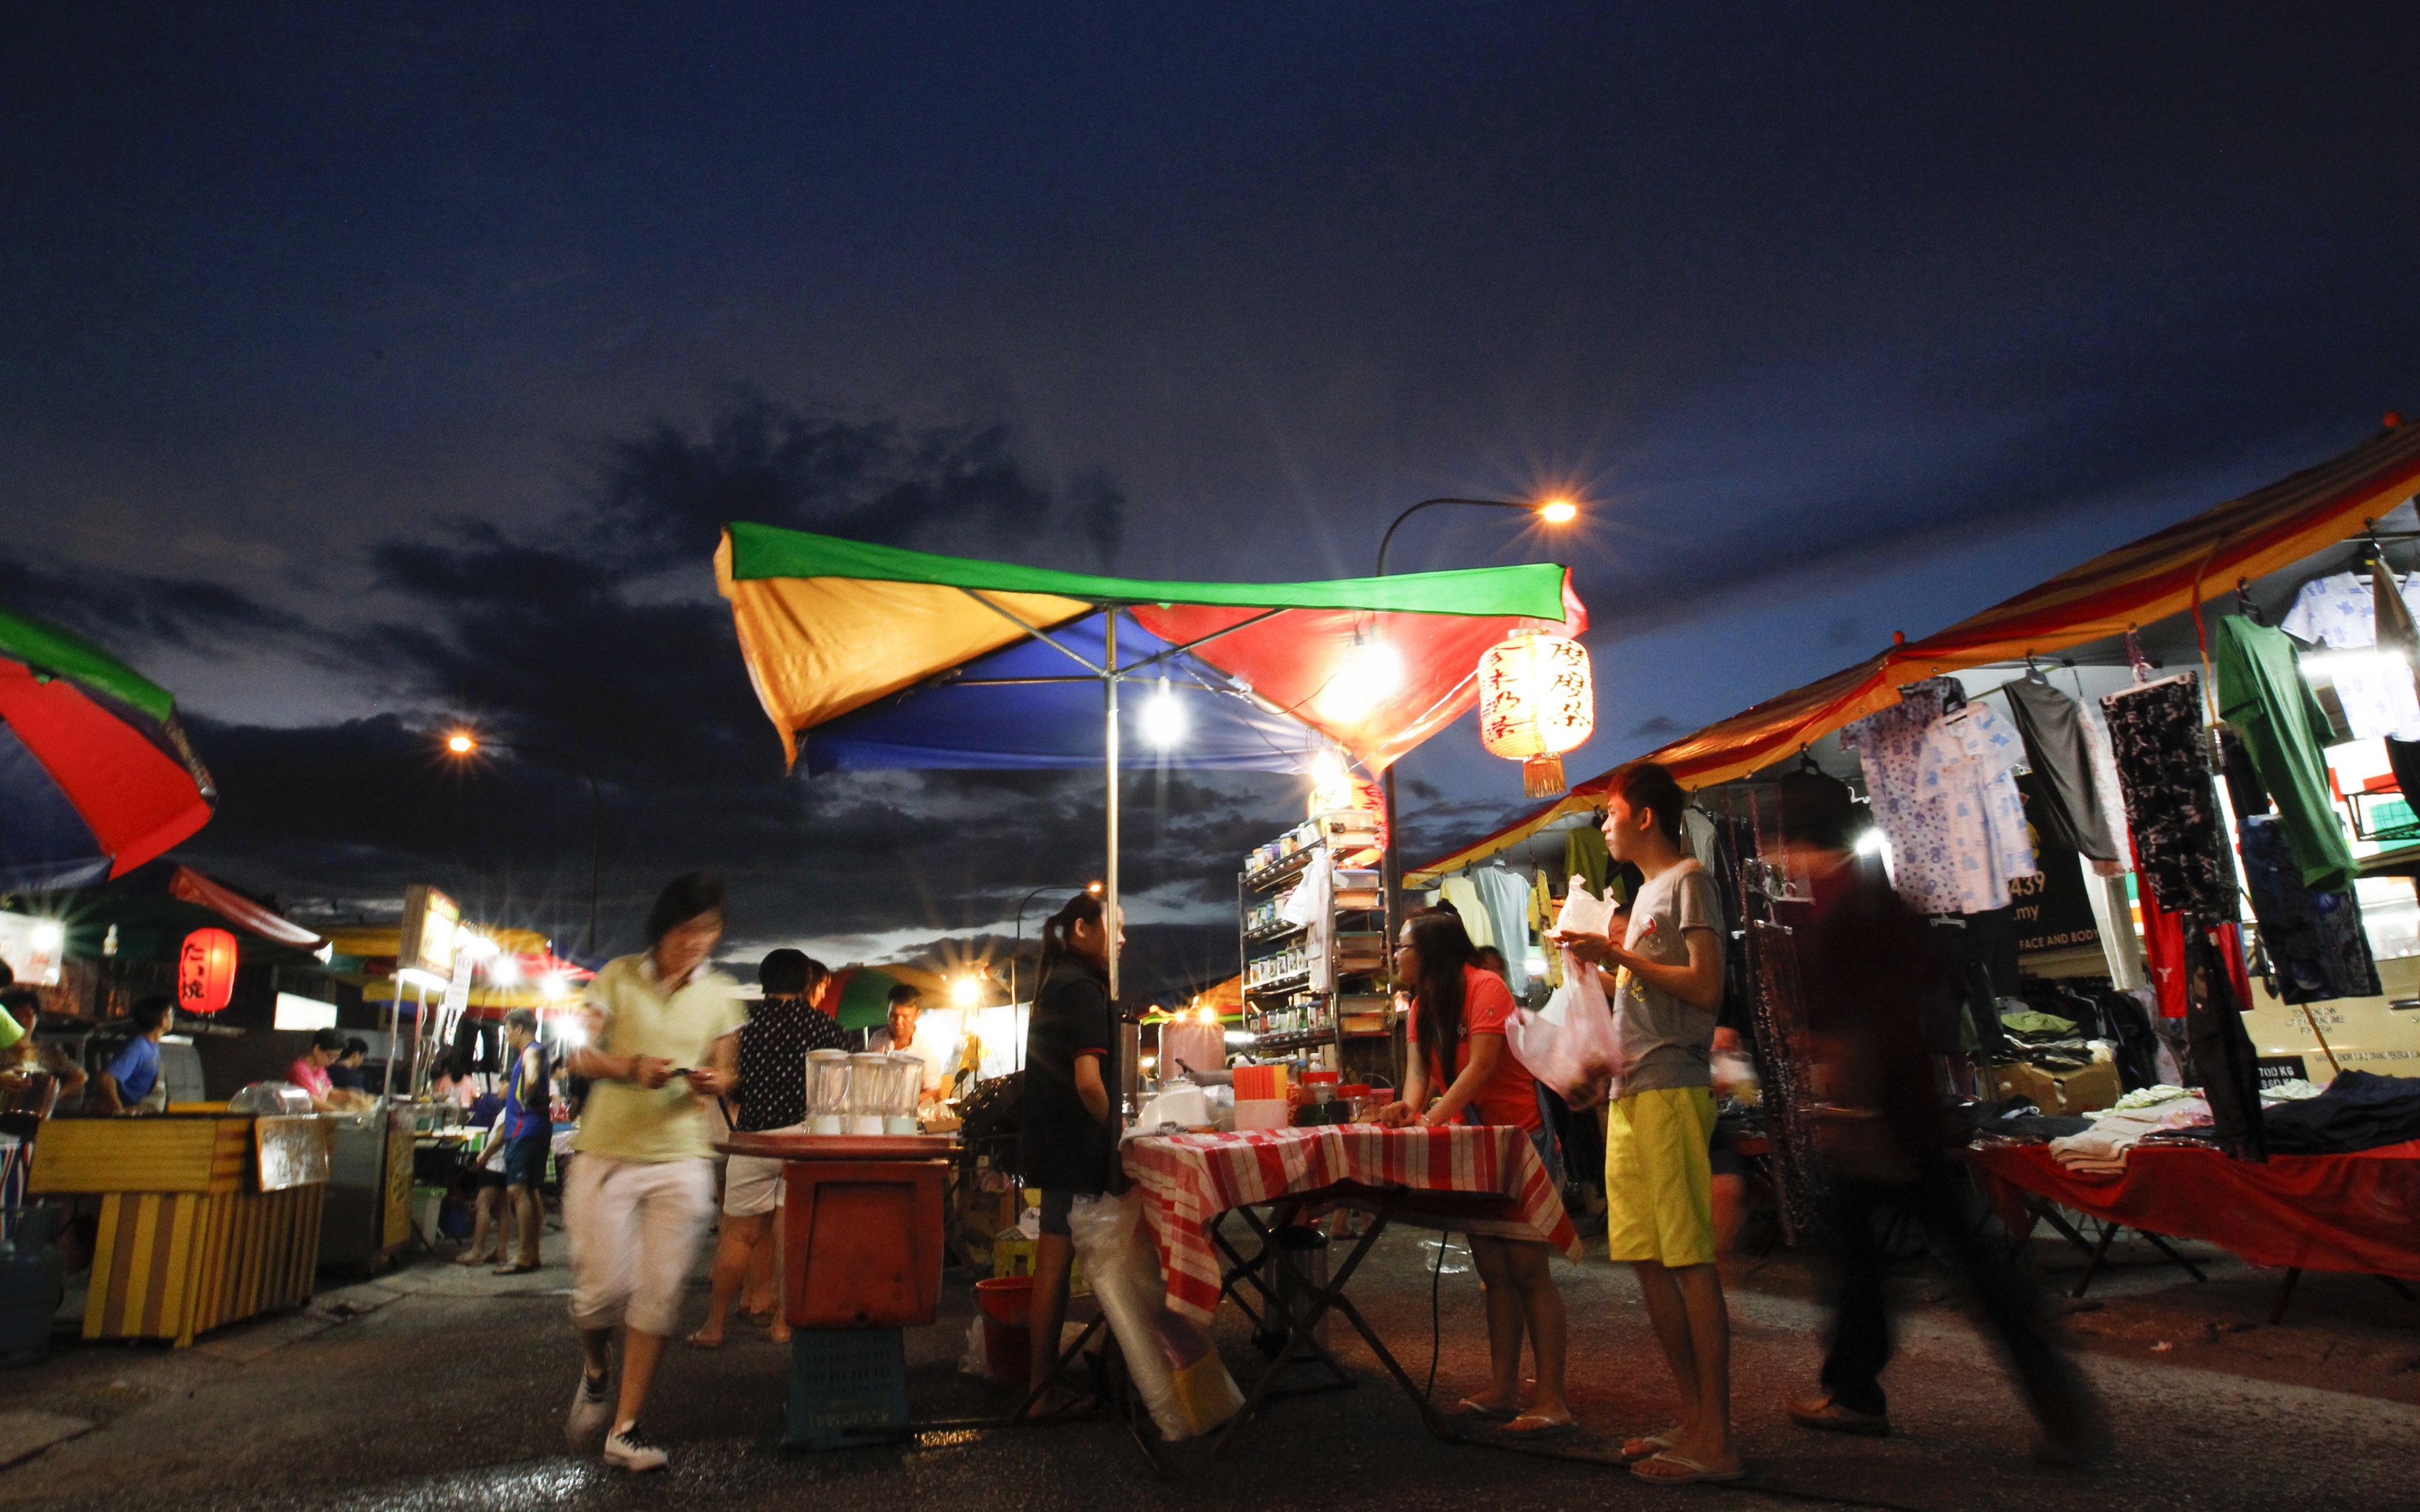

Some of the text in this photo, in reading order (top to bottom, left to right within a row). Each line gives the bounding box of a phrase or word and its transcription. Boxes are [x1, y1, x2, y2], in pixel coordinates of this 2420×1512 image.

[2019, 937, 2044, 950] FACE
[2047, 934, 2068, 945] AND
[2279, 1066, 2294, 1076] KG
